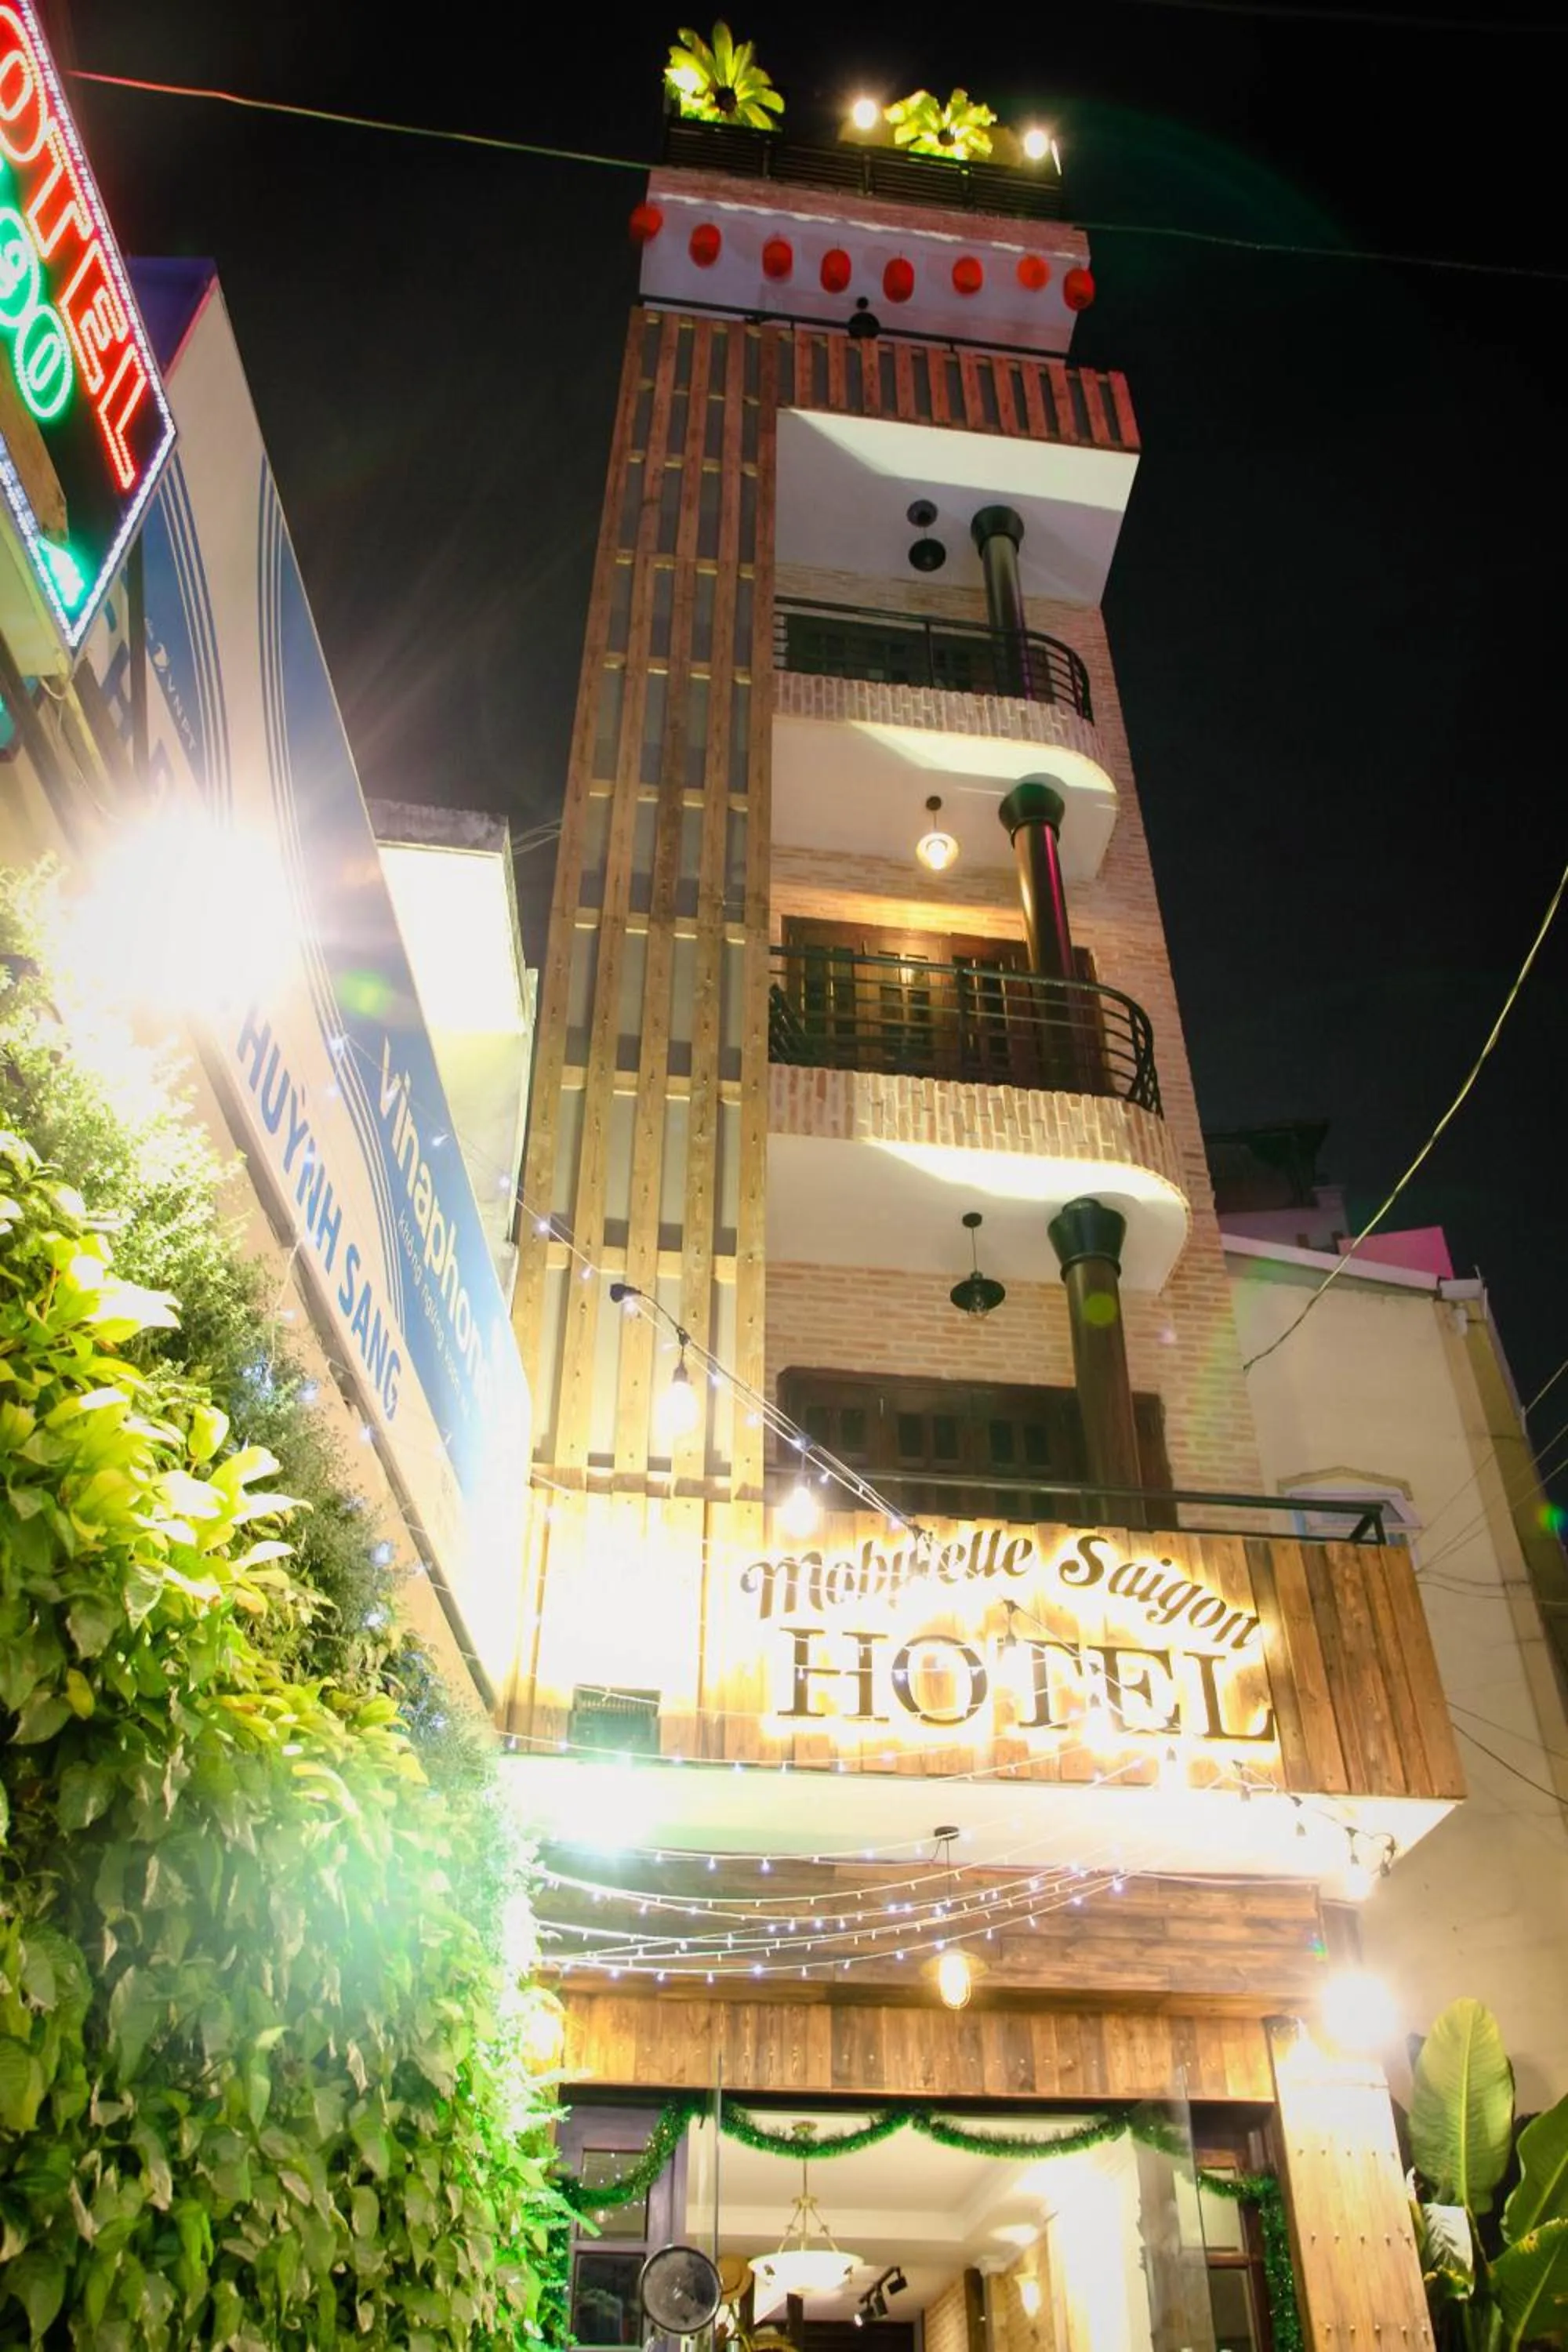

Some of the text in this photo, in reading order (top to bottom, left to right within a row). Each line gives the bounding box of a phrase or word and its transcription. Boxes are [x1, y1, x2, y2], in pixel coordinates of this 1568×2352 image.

[338, 1242, 401, 1421] SANG
[1058, 1534, 1260, 1649] Saigon
[777, 1626, 1276, 1741] HOTEL
